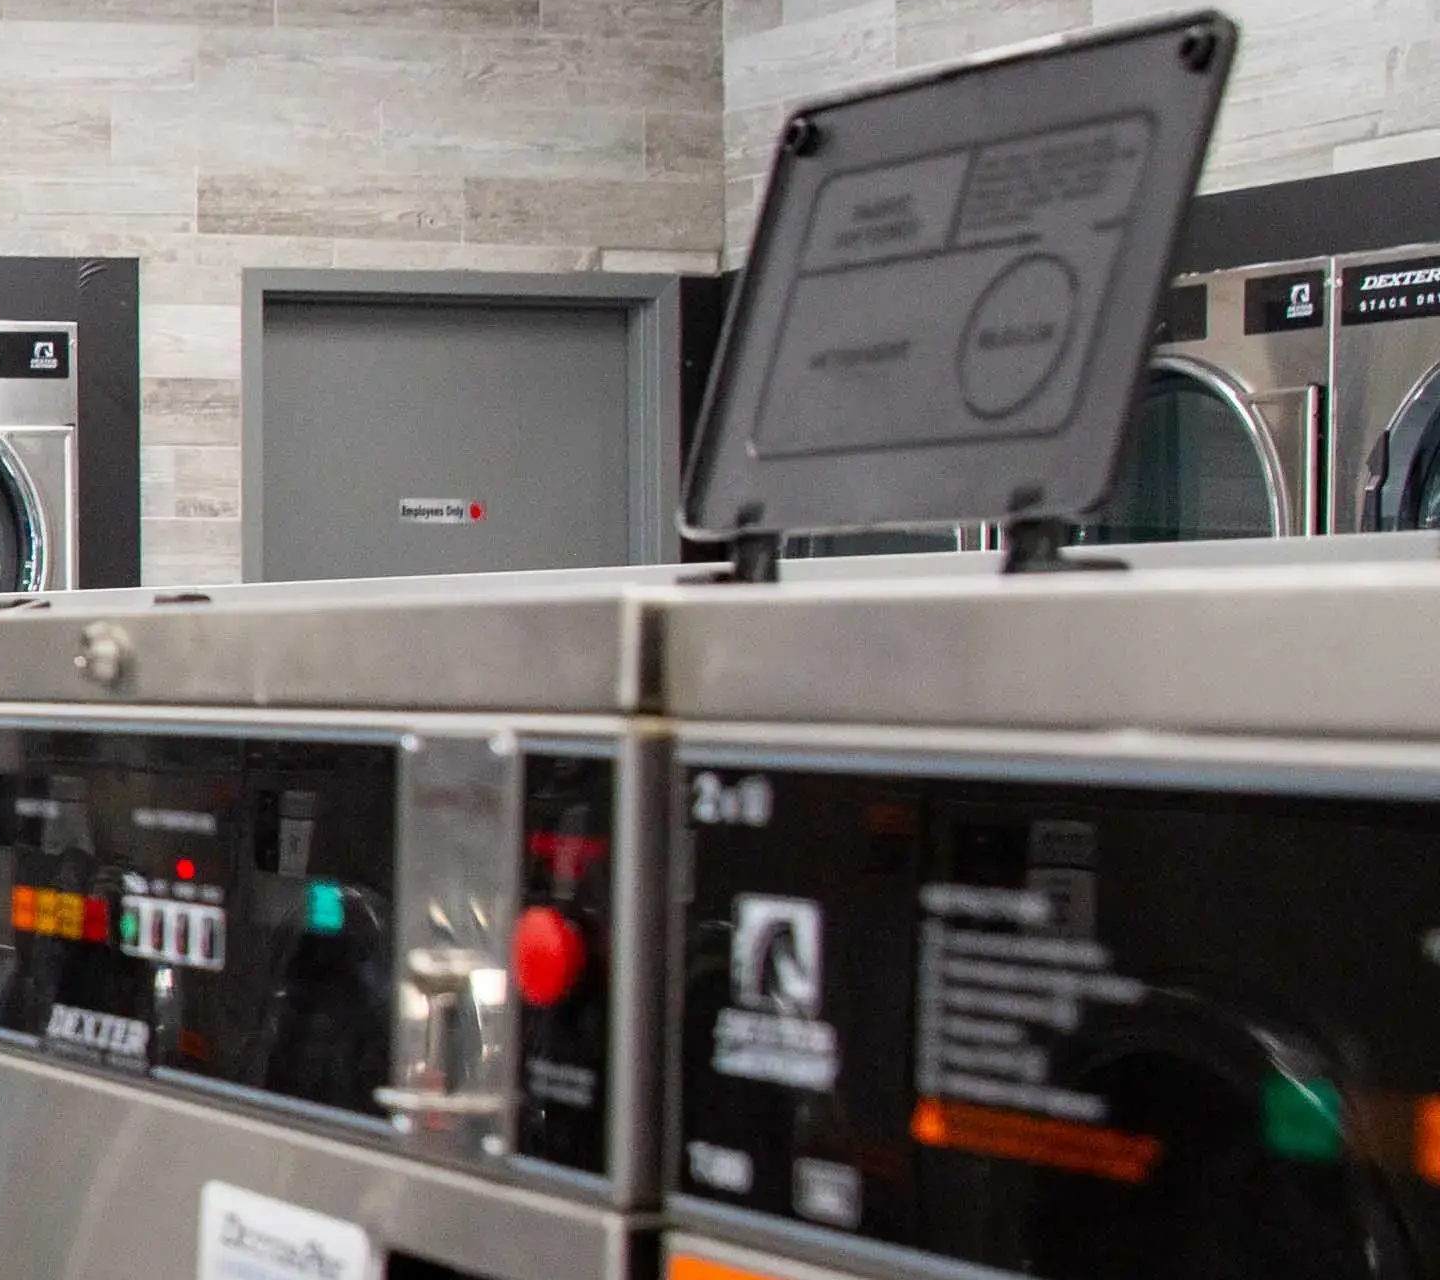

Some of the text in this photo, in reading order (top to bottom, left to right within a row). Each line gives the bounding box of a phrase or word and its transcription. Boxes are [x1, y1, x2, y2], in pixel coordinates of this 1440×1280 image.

[1360, 267, 1440, 291] DEXTER
[402, 505, 464, 519] Employees Only
[46, 1003, 150, 1057] DEXTER
